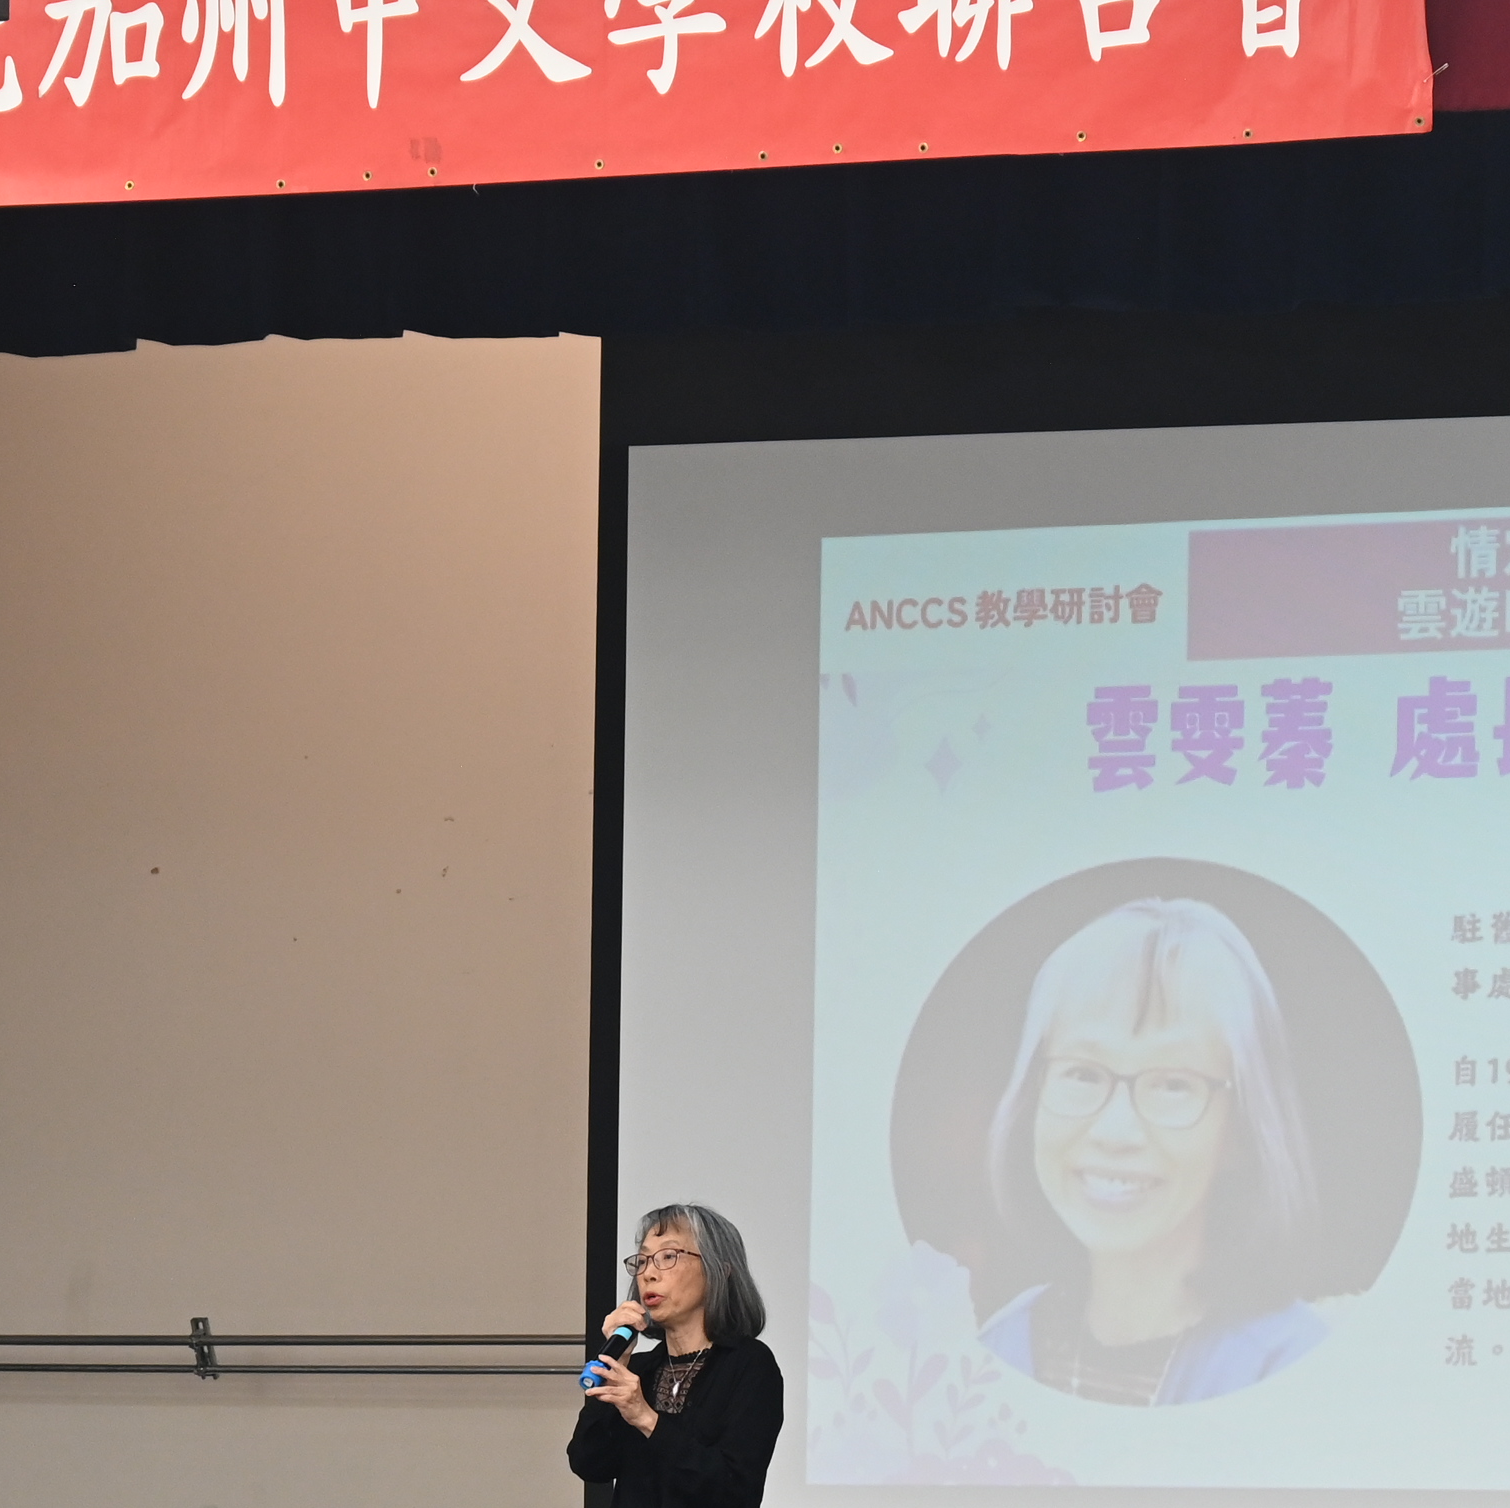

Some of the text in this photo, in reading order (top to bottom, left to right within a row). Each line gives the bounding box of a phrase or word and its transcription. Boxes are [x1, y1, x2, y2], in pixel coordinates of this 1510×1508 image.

[844, 582, 1164, 632] ANCCS 教學研討會
[1086, 676, 1334, 793] 雲雯蓁
[1444, 1334, 1504, 1367] 流。
